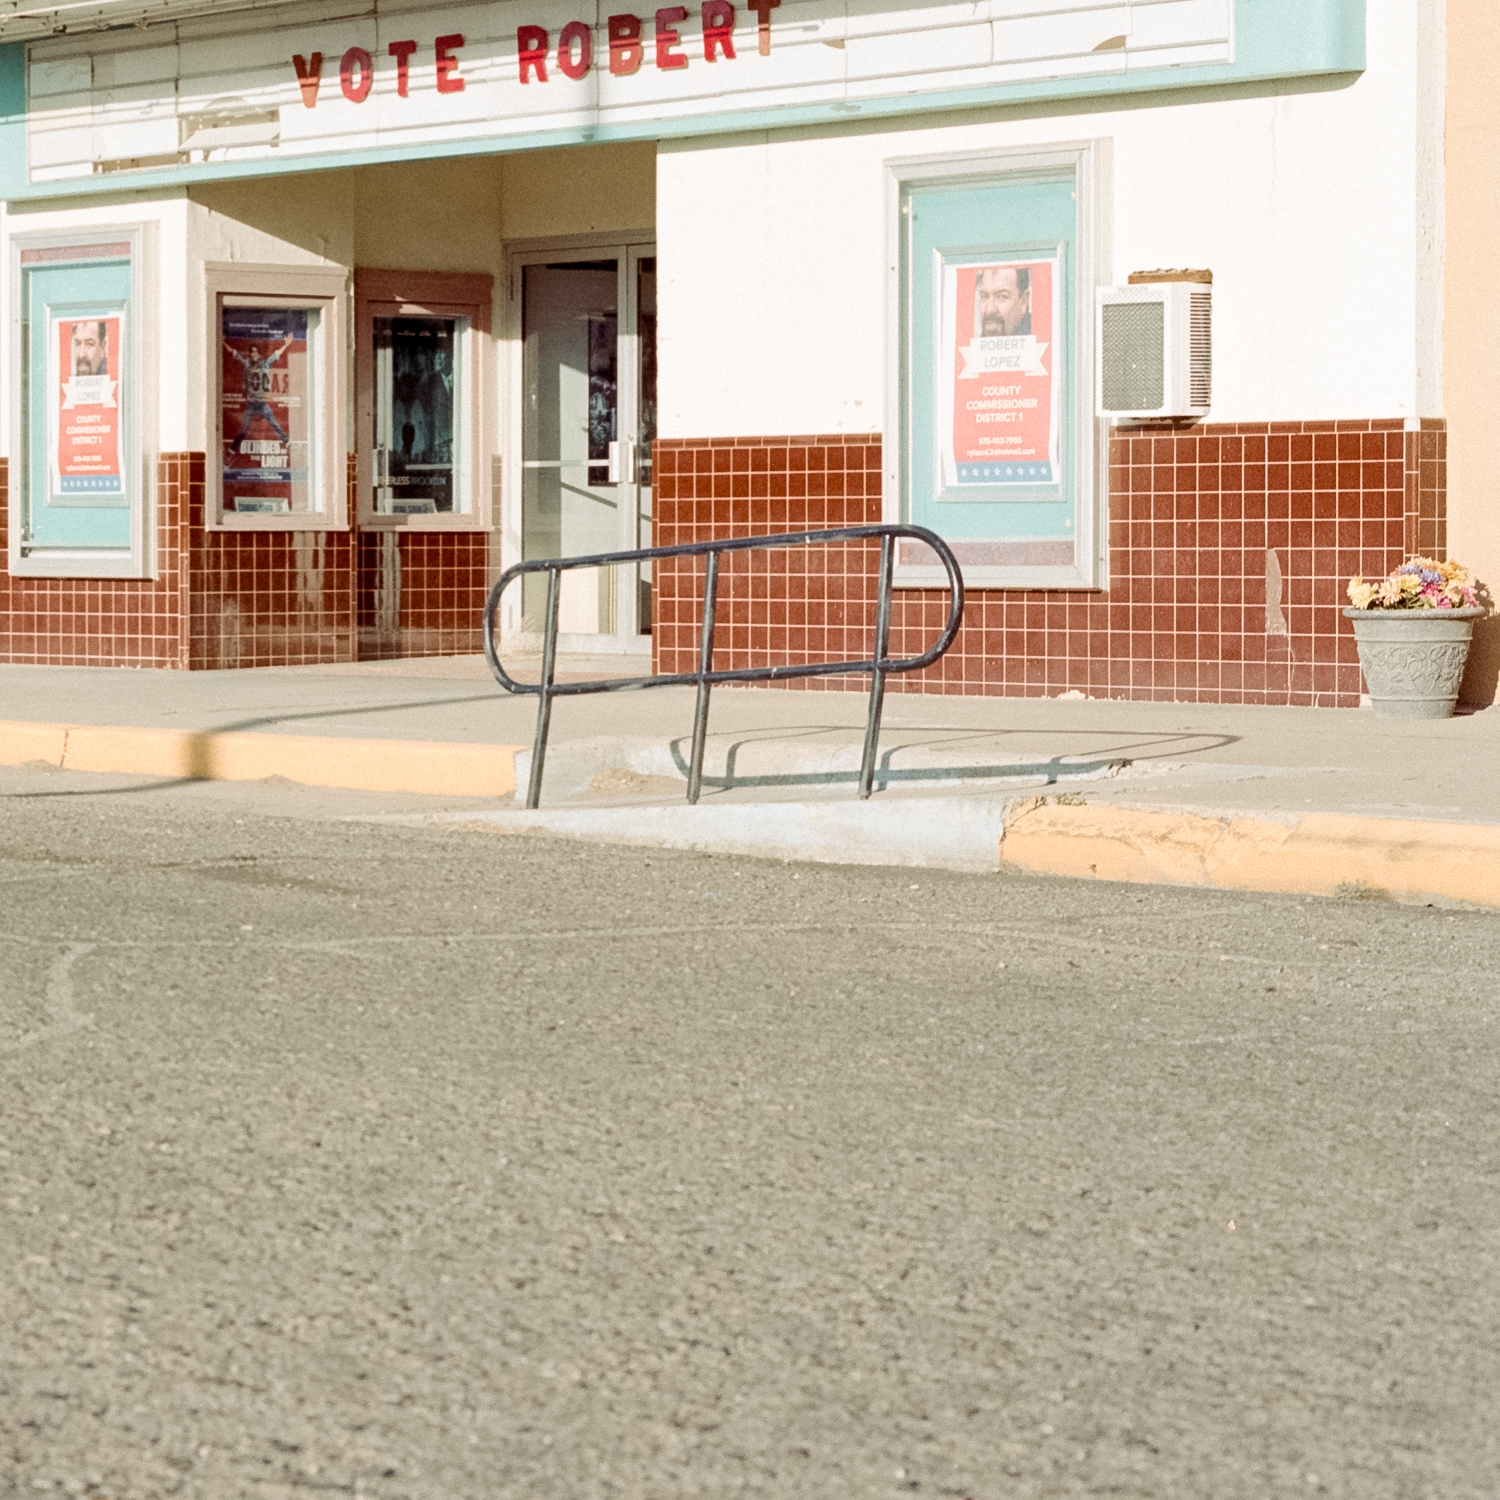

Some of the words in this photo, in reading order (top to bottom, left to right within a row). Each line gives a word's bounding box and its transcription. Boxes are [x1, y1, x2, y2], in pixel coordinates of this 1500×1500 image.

[292, 33, 466, 109] VOTE
[980, 338, 1026, 351] ROBERT
[984, 355, 1021, 368] LOPEZ
[981, 385, 1022, 396] COUNTY
[966, 398, 1039, 410] COMMISSIONER
[975, 412, 1017, 424] DISTRICT
[261, 455, 289, 468] LIGHT
